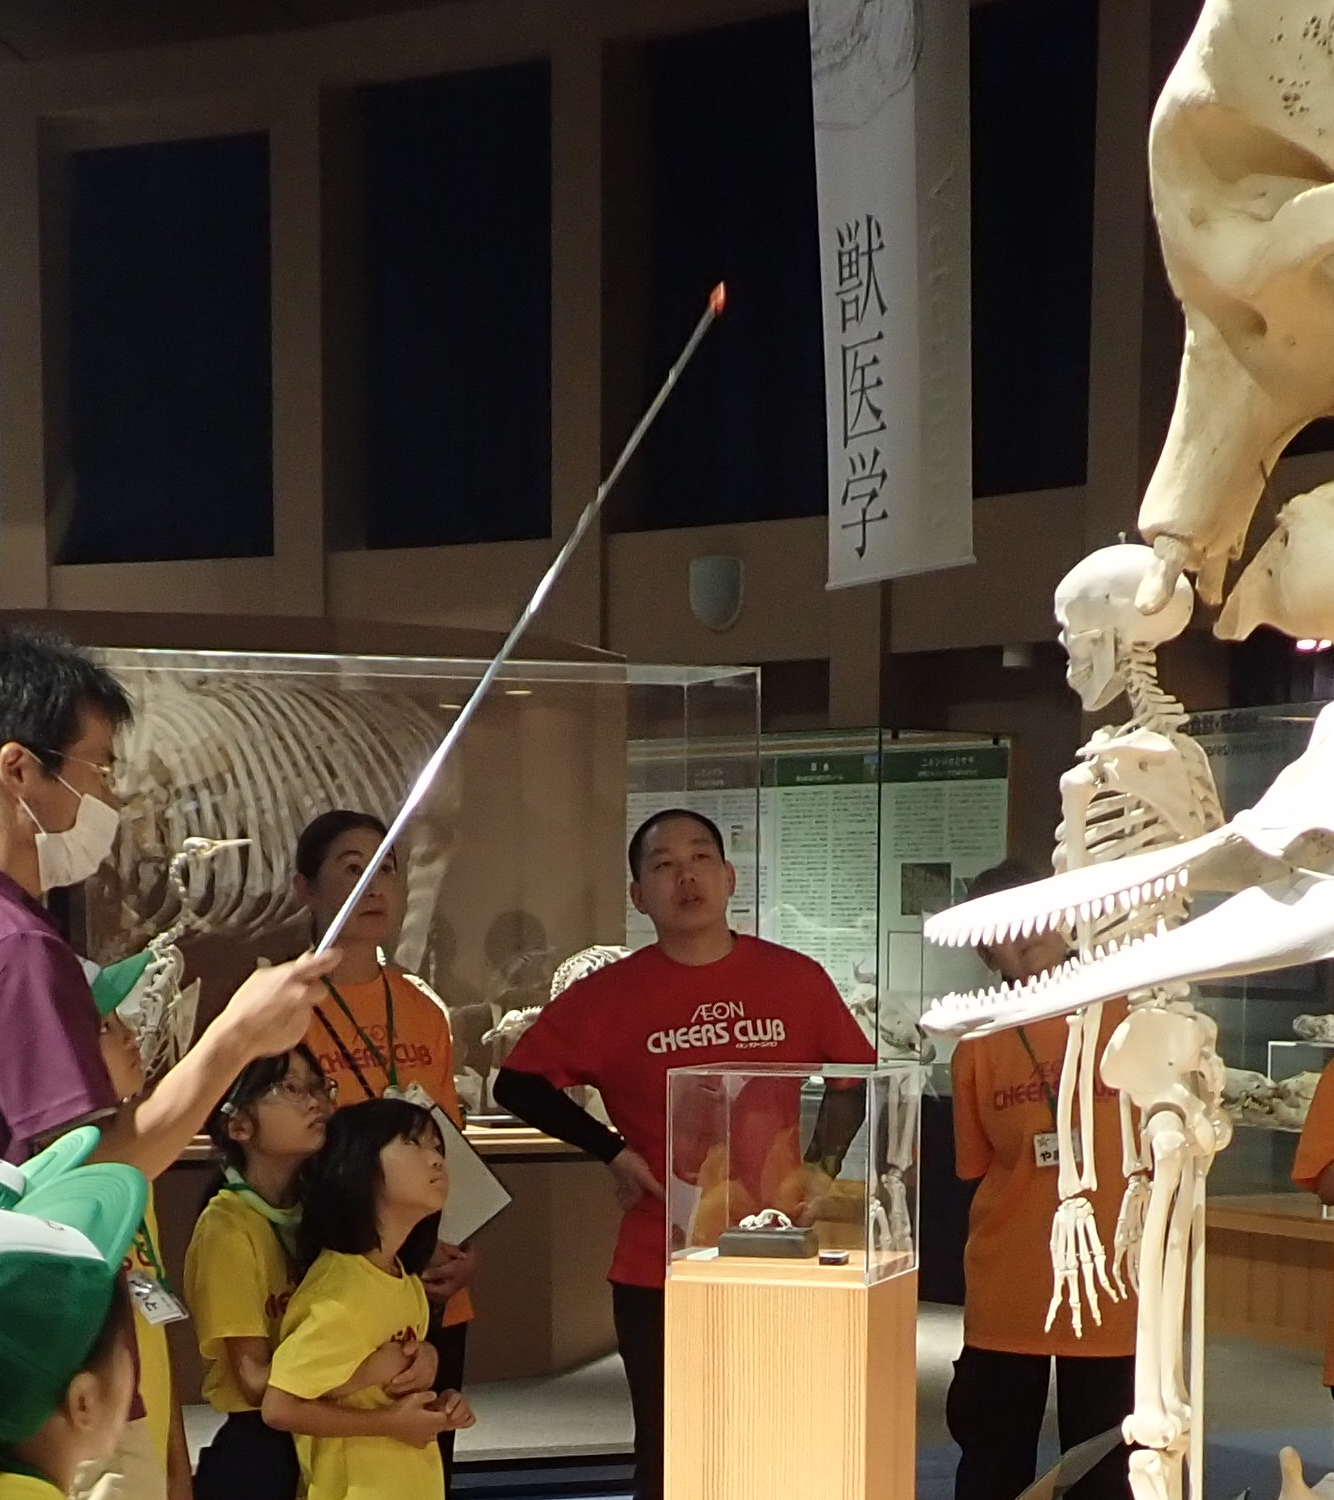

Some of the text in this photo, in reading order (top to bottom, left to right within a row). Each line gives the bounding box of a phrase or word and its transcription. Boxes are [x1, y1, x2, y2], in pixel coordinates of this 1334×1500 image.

[834, 212, 889, 560] 獣医学
[646, 1018, 786, 1054] CHEERS CLUB
